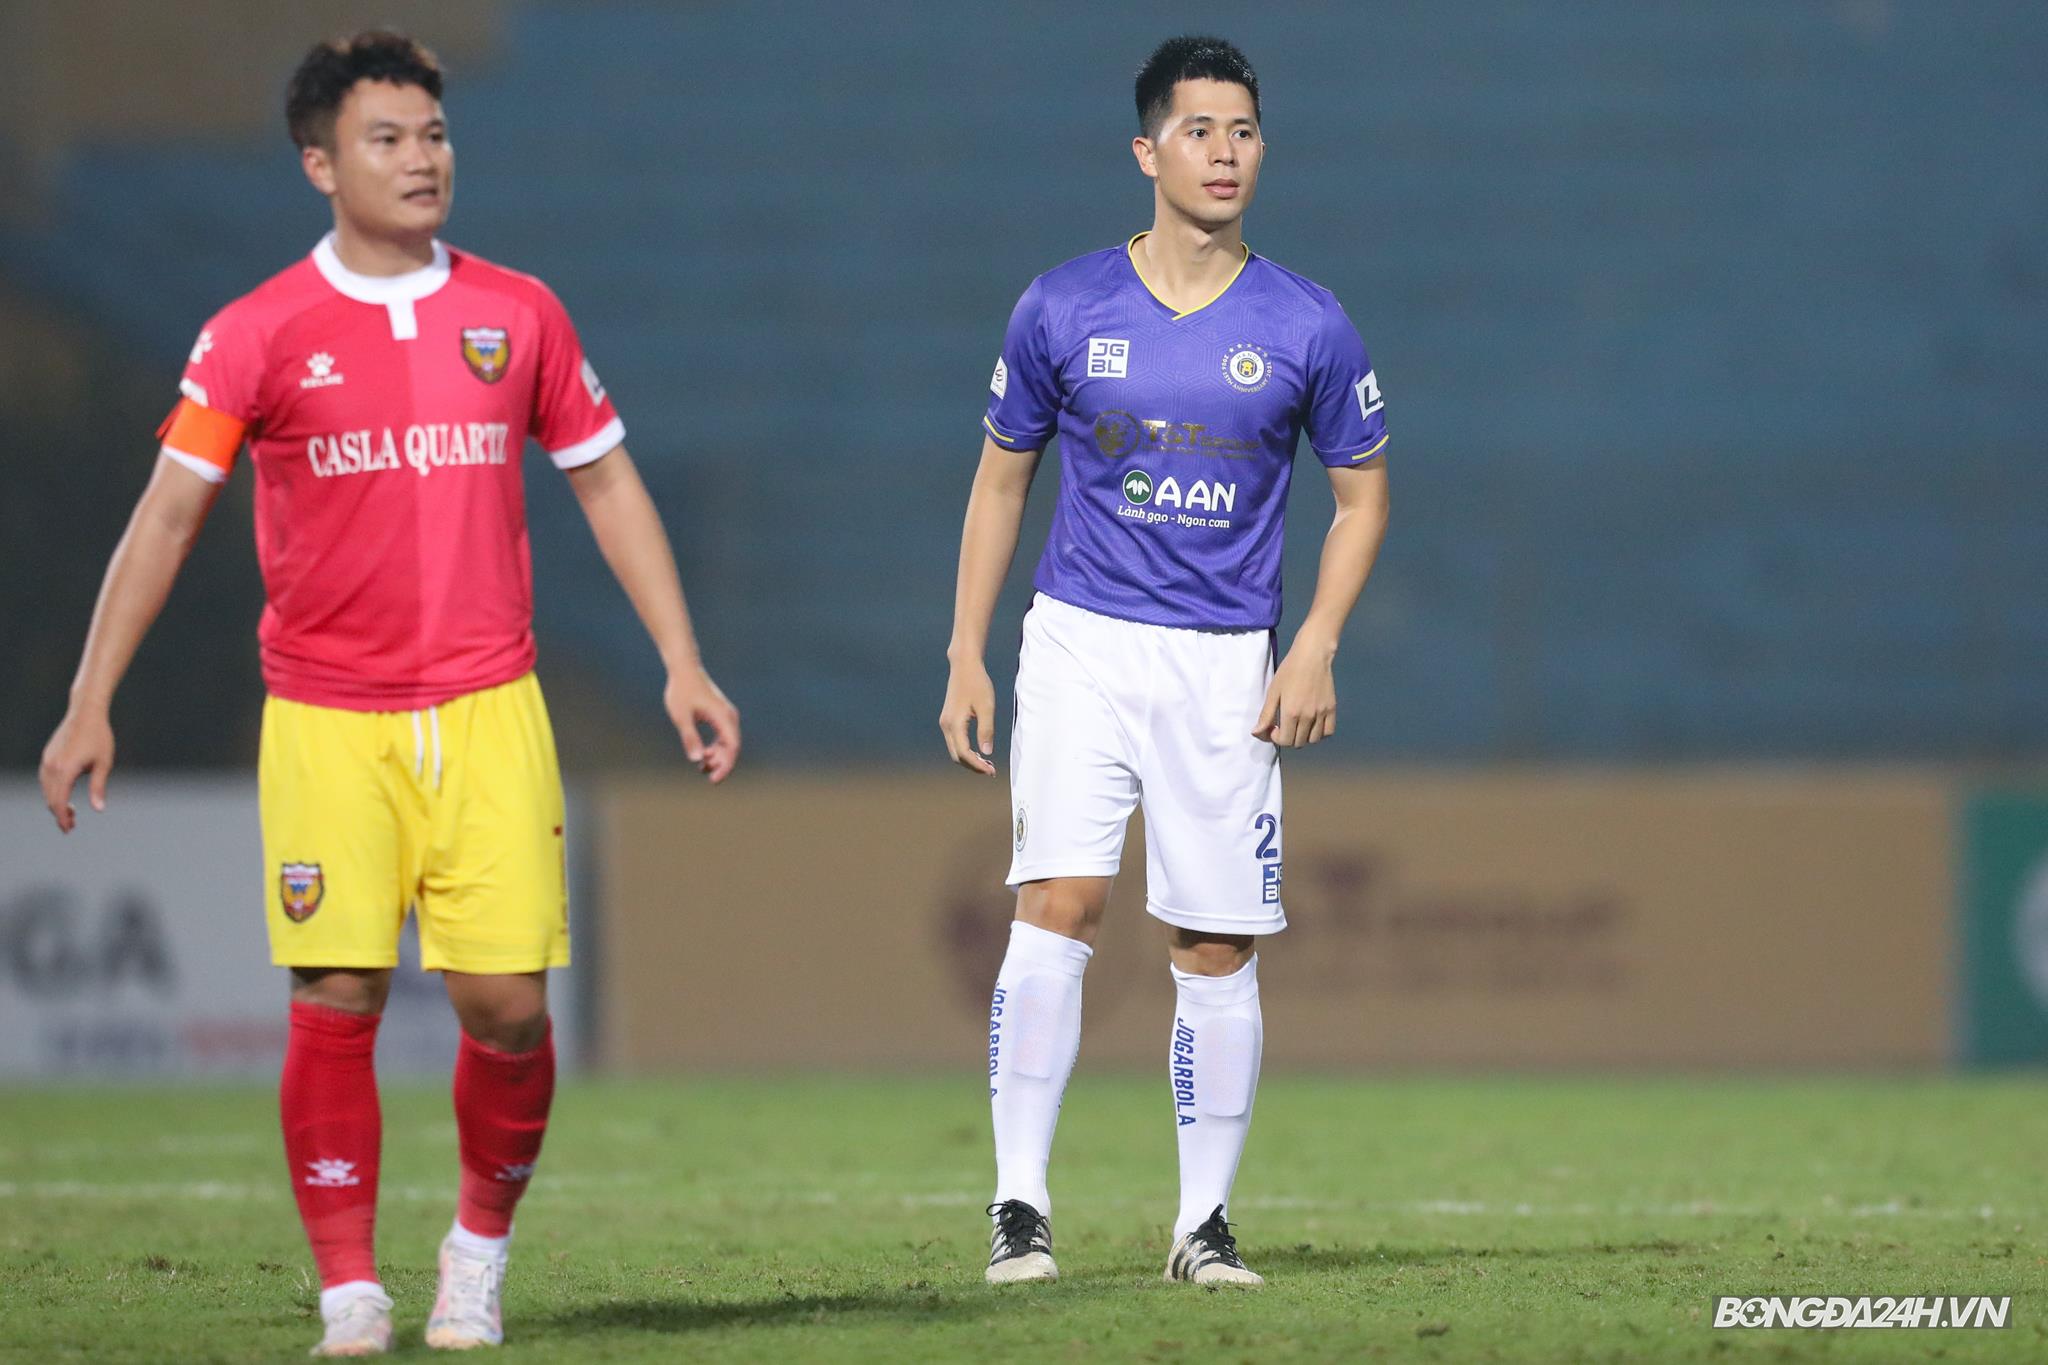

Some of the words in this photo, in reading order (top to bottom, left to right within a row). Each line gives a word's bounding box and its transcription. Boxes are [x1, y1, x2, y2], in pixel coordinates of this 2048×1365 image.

[307, 426, 402, 478] CASLA
[1177, 513, 1206, 528] Ngon
[1173, 1017, 1196, 1126] JOGARBOLA
